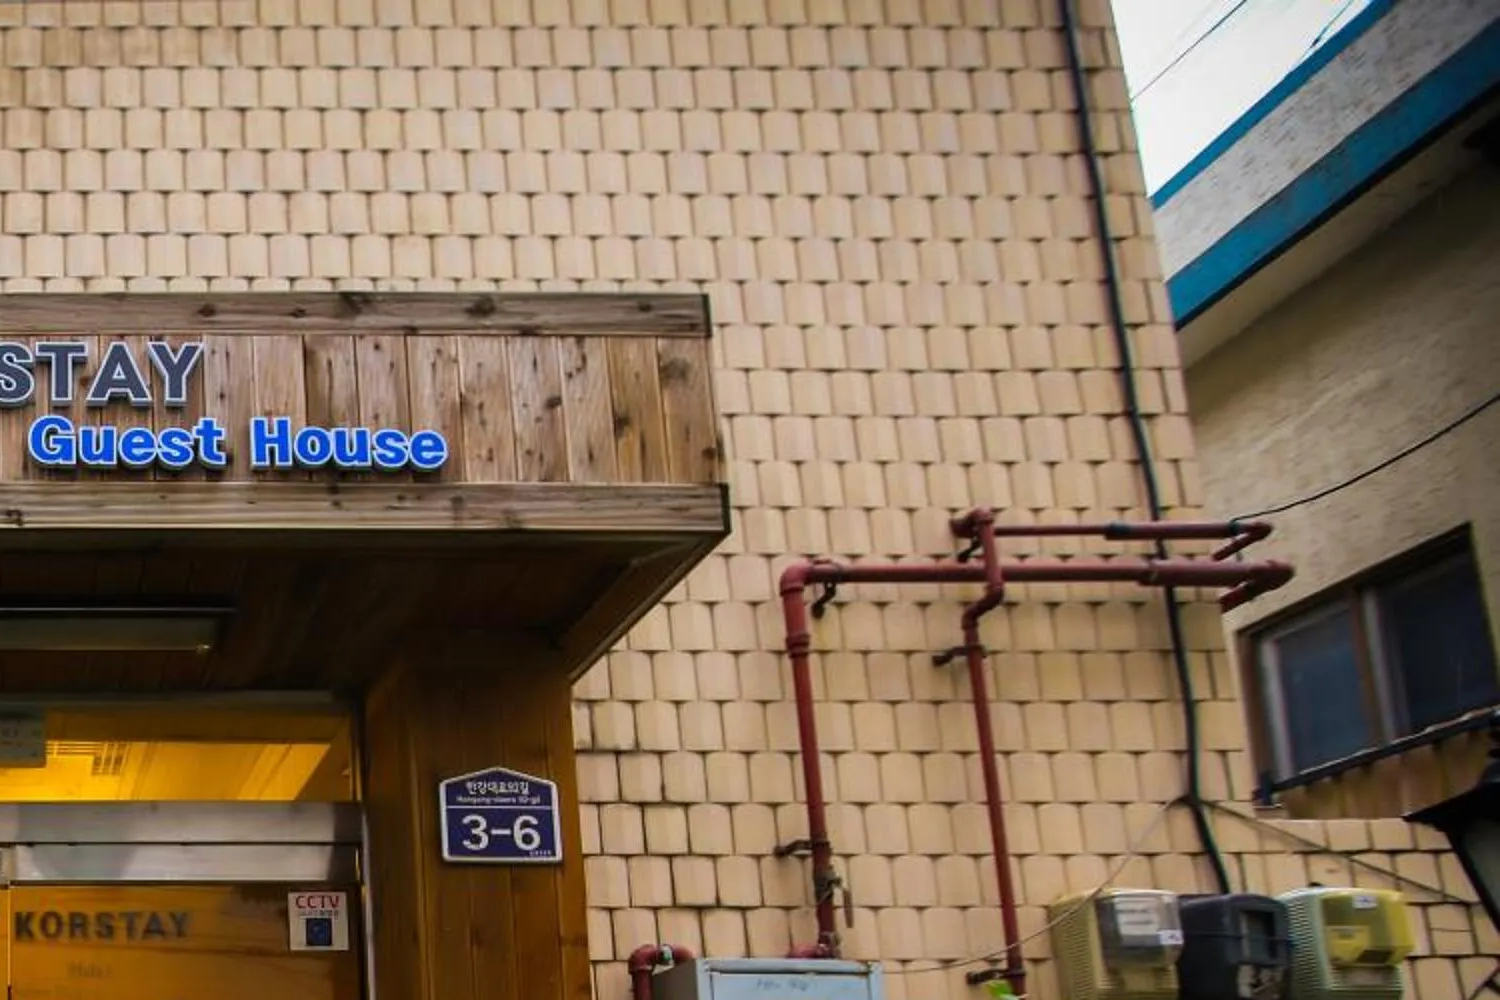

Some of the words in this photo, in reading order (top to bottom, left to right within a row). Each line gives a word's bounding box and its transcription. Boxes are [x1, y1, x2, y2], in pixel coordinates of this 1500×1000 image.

[29, 416, 225, 469] Guest
[250, 415, 449, 470] House
[462, 814, 541, 850] 3-6
[295, 895, 340, 909] CCTV
[13, 910, 192, 942] KORSTAY
